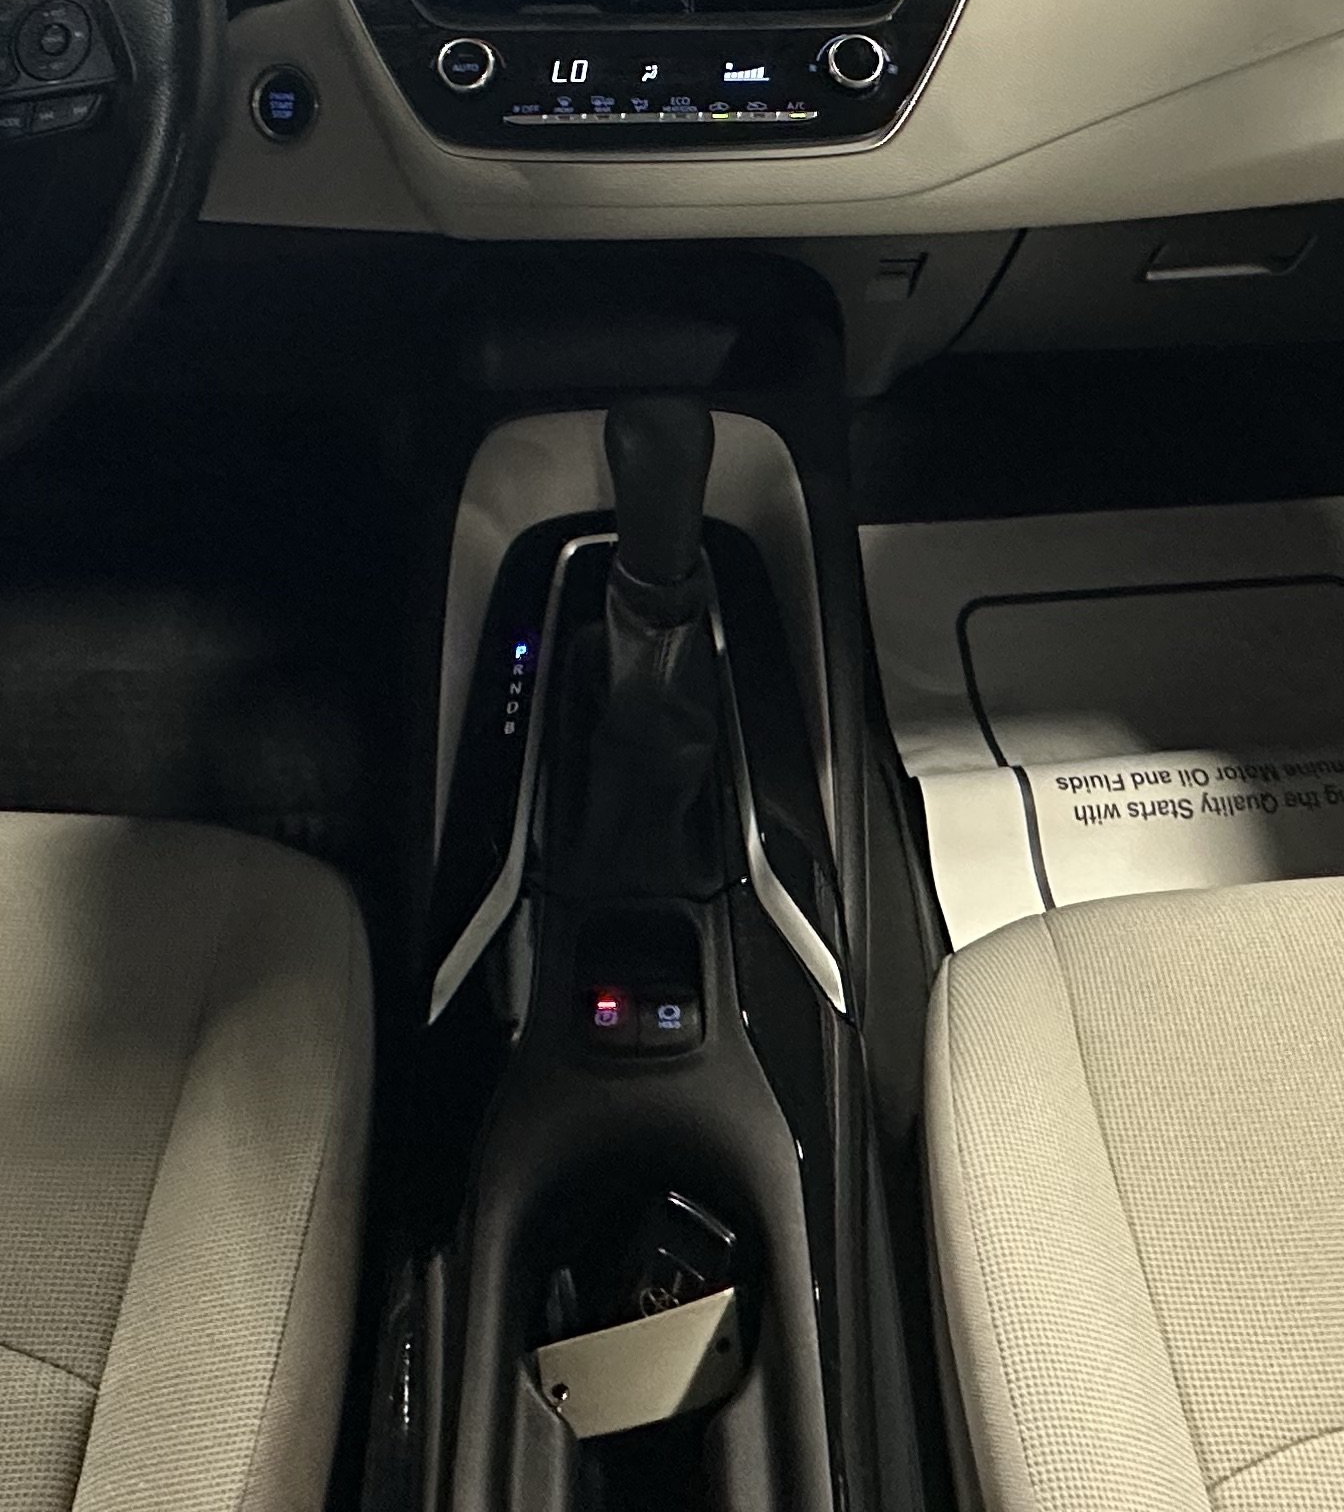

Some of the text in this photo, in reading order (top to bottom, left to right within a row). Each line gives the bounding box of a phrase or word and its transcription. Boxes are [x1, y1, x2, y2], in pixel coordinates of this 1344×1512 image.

[452, 63, 479, 72] AUTO
[551, 59, 589, 83] LO
[670, 96, 691, 106] ECO
[787, 101, 805, 110] A/C
[515, 645, 527, 659] P
[513, 664, 524, 676] R
[510, 681, 522, 695] N
[506, 701, 519, 715] D
[1131, 769, 1172, 790] and
[1178, 768, 1210, 788] Oil
[1215, 762, 1281, 782] Motor
[1055, 773, 1125, 794] Fluids
[1127, 798, 1194, 820] Starts
[1200, 791, 1279, 817] Quality
[1283, 791, 1322, 812] the
[1073, 803, 1121, 826] with
